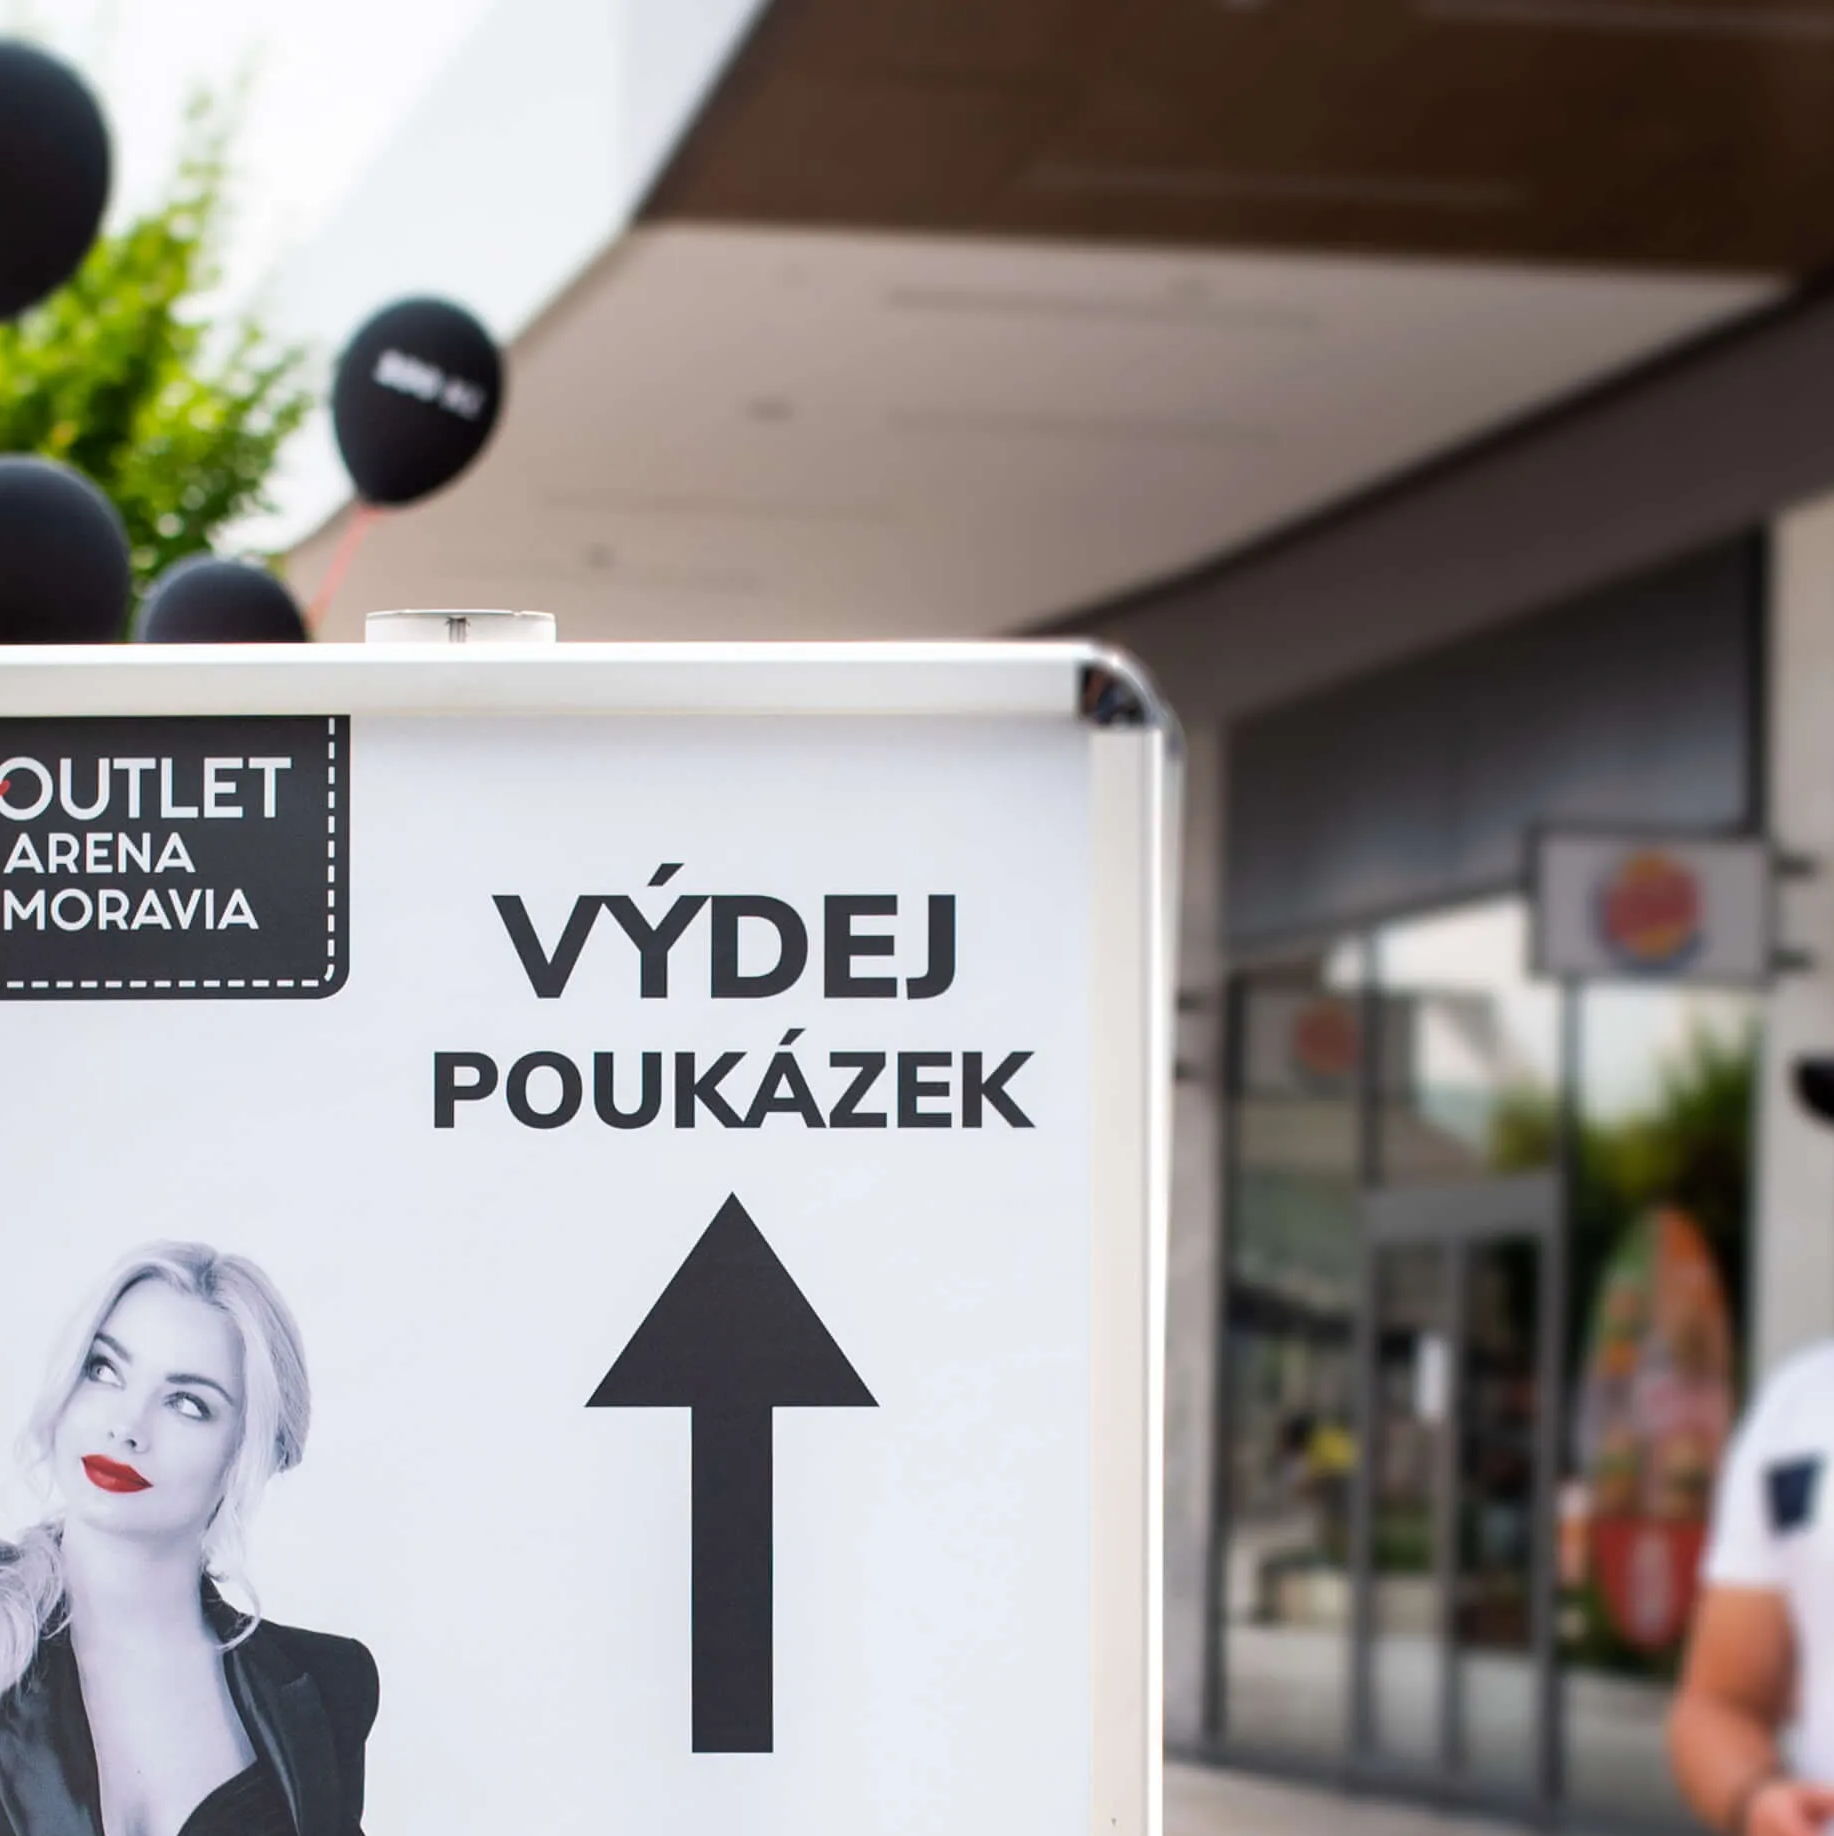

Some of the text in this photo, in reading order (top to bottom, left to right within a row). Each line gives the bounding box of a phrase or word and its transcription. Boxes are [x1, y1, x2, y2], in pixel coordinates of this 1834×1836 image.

[2, 831, 196, 874] ARENA
[2, 888, 259, 931] MORAVIA
[491, 862, 957, 1000] VÝDEJ
[433, 1027, 1036, 1129] POUKÁZEK
